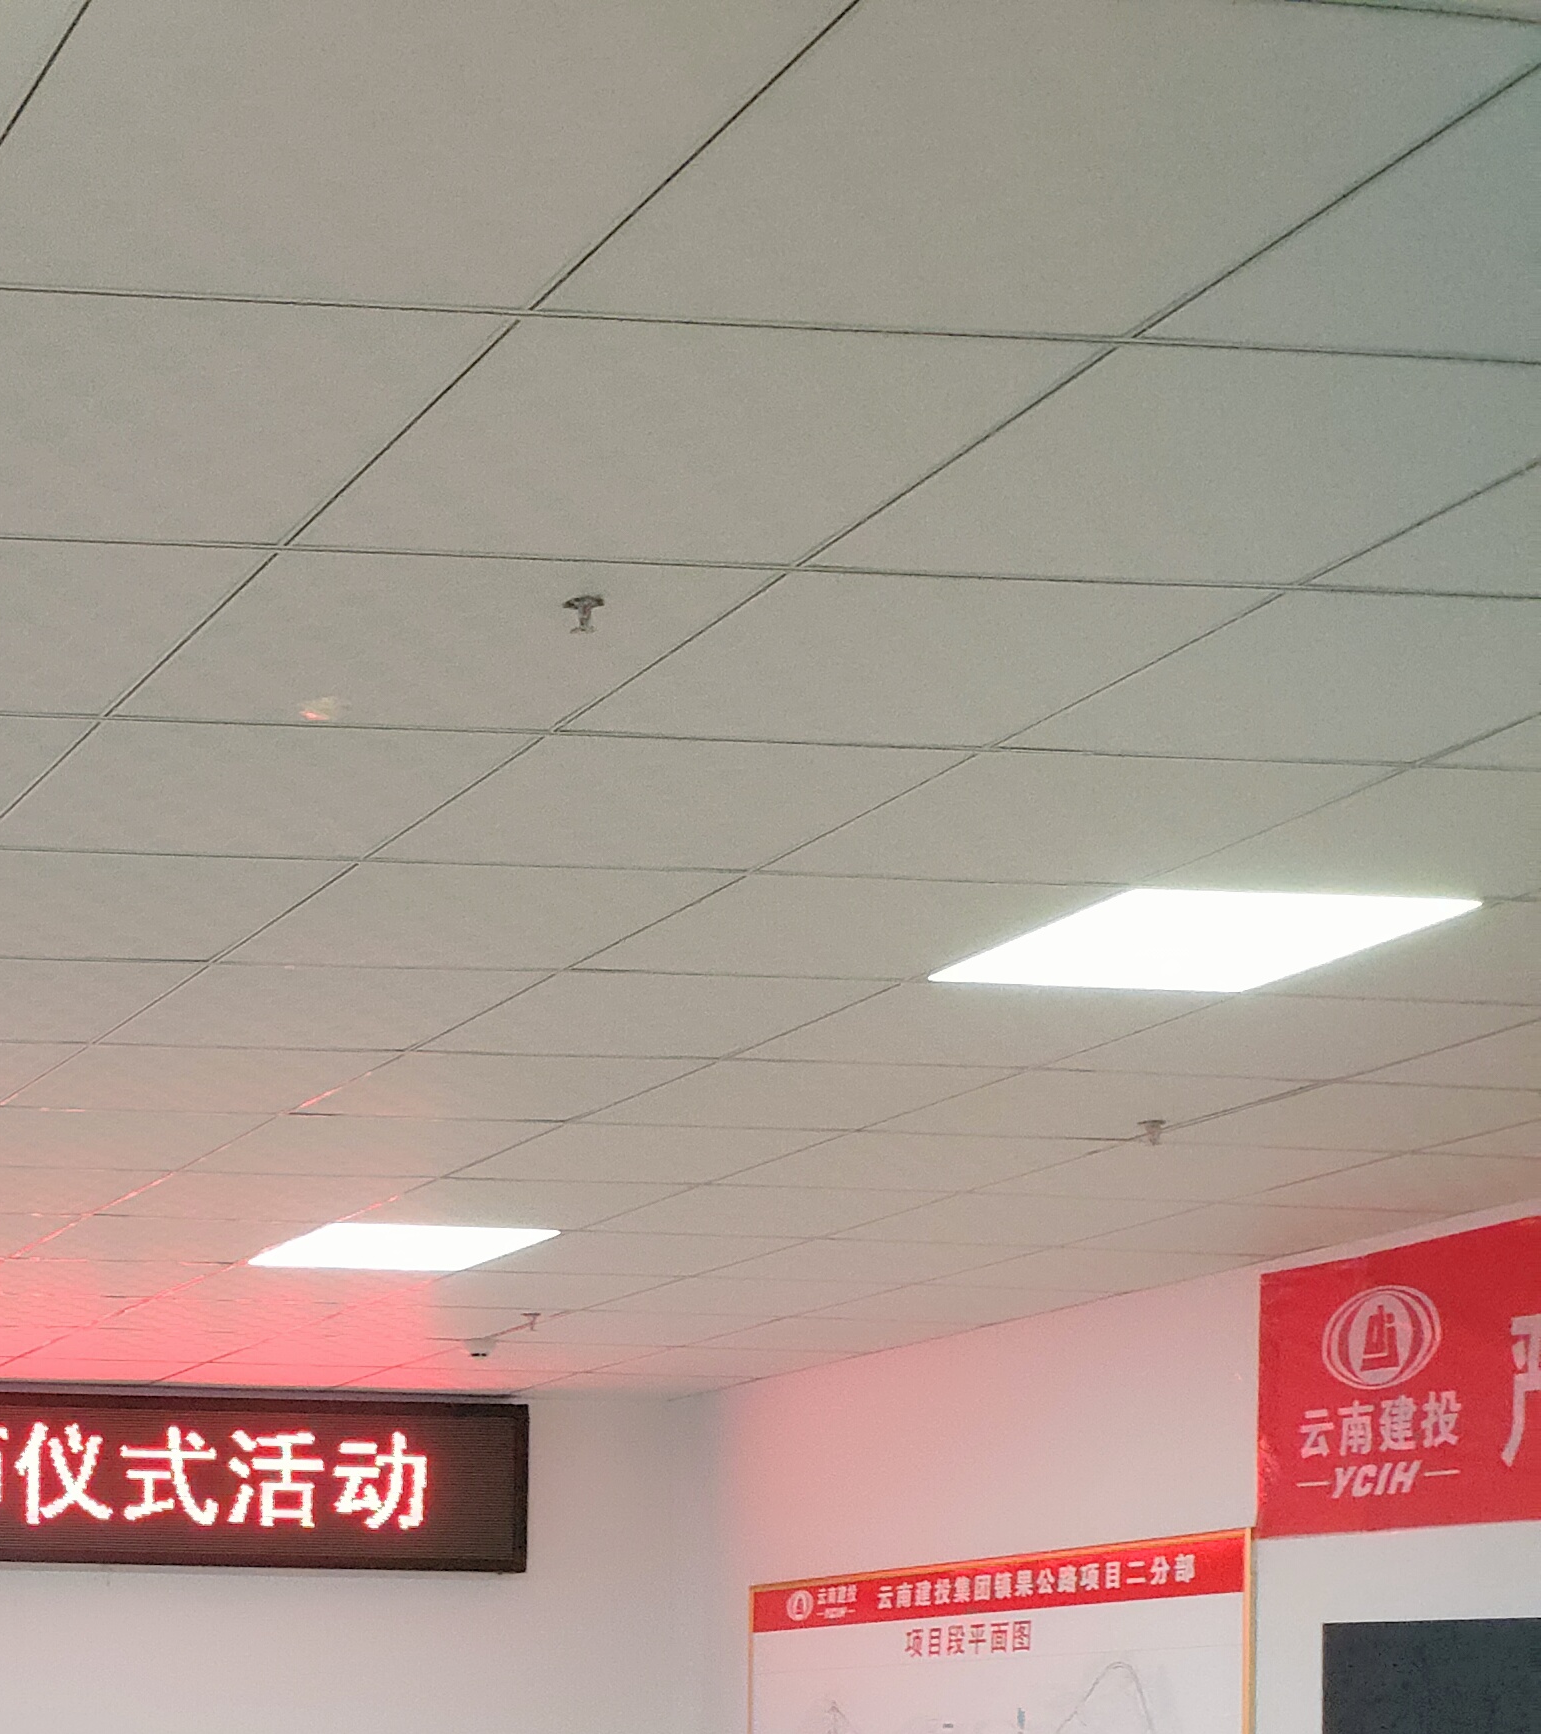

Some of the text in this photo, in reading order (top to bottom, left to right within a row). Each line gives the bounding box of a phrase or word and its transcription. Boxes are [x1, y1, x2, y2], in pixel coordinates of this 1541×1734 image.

[1299, 1390, 1462, 1458] 云南建投
[1332, 1459, 1422, 1499] YCIH
[905, 1619, 1032, 1658] 项目段平面图
